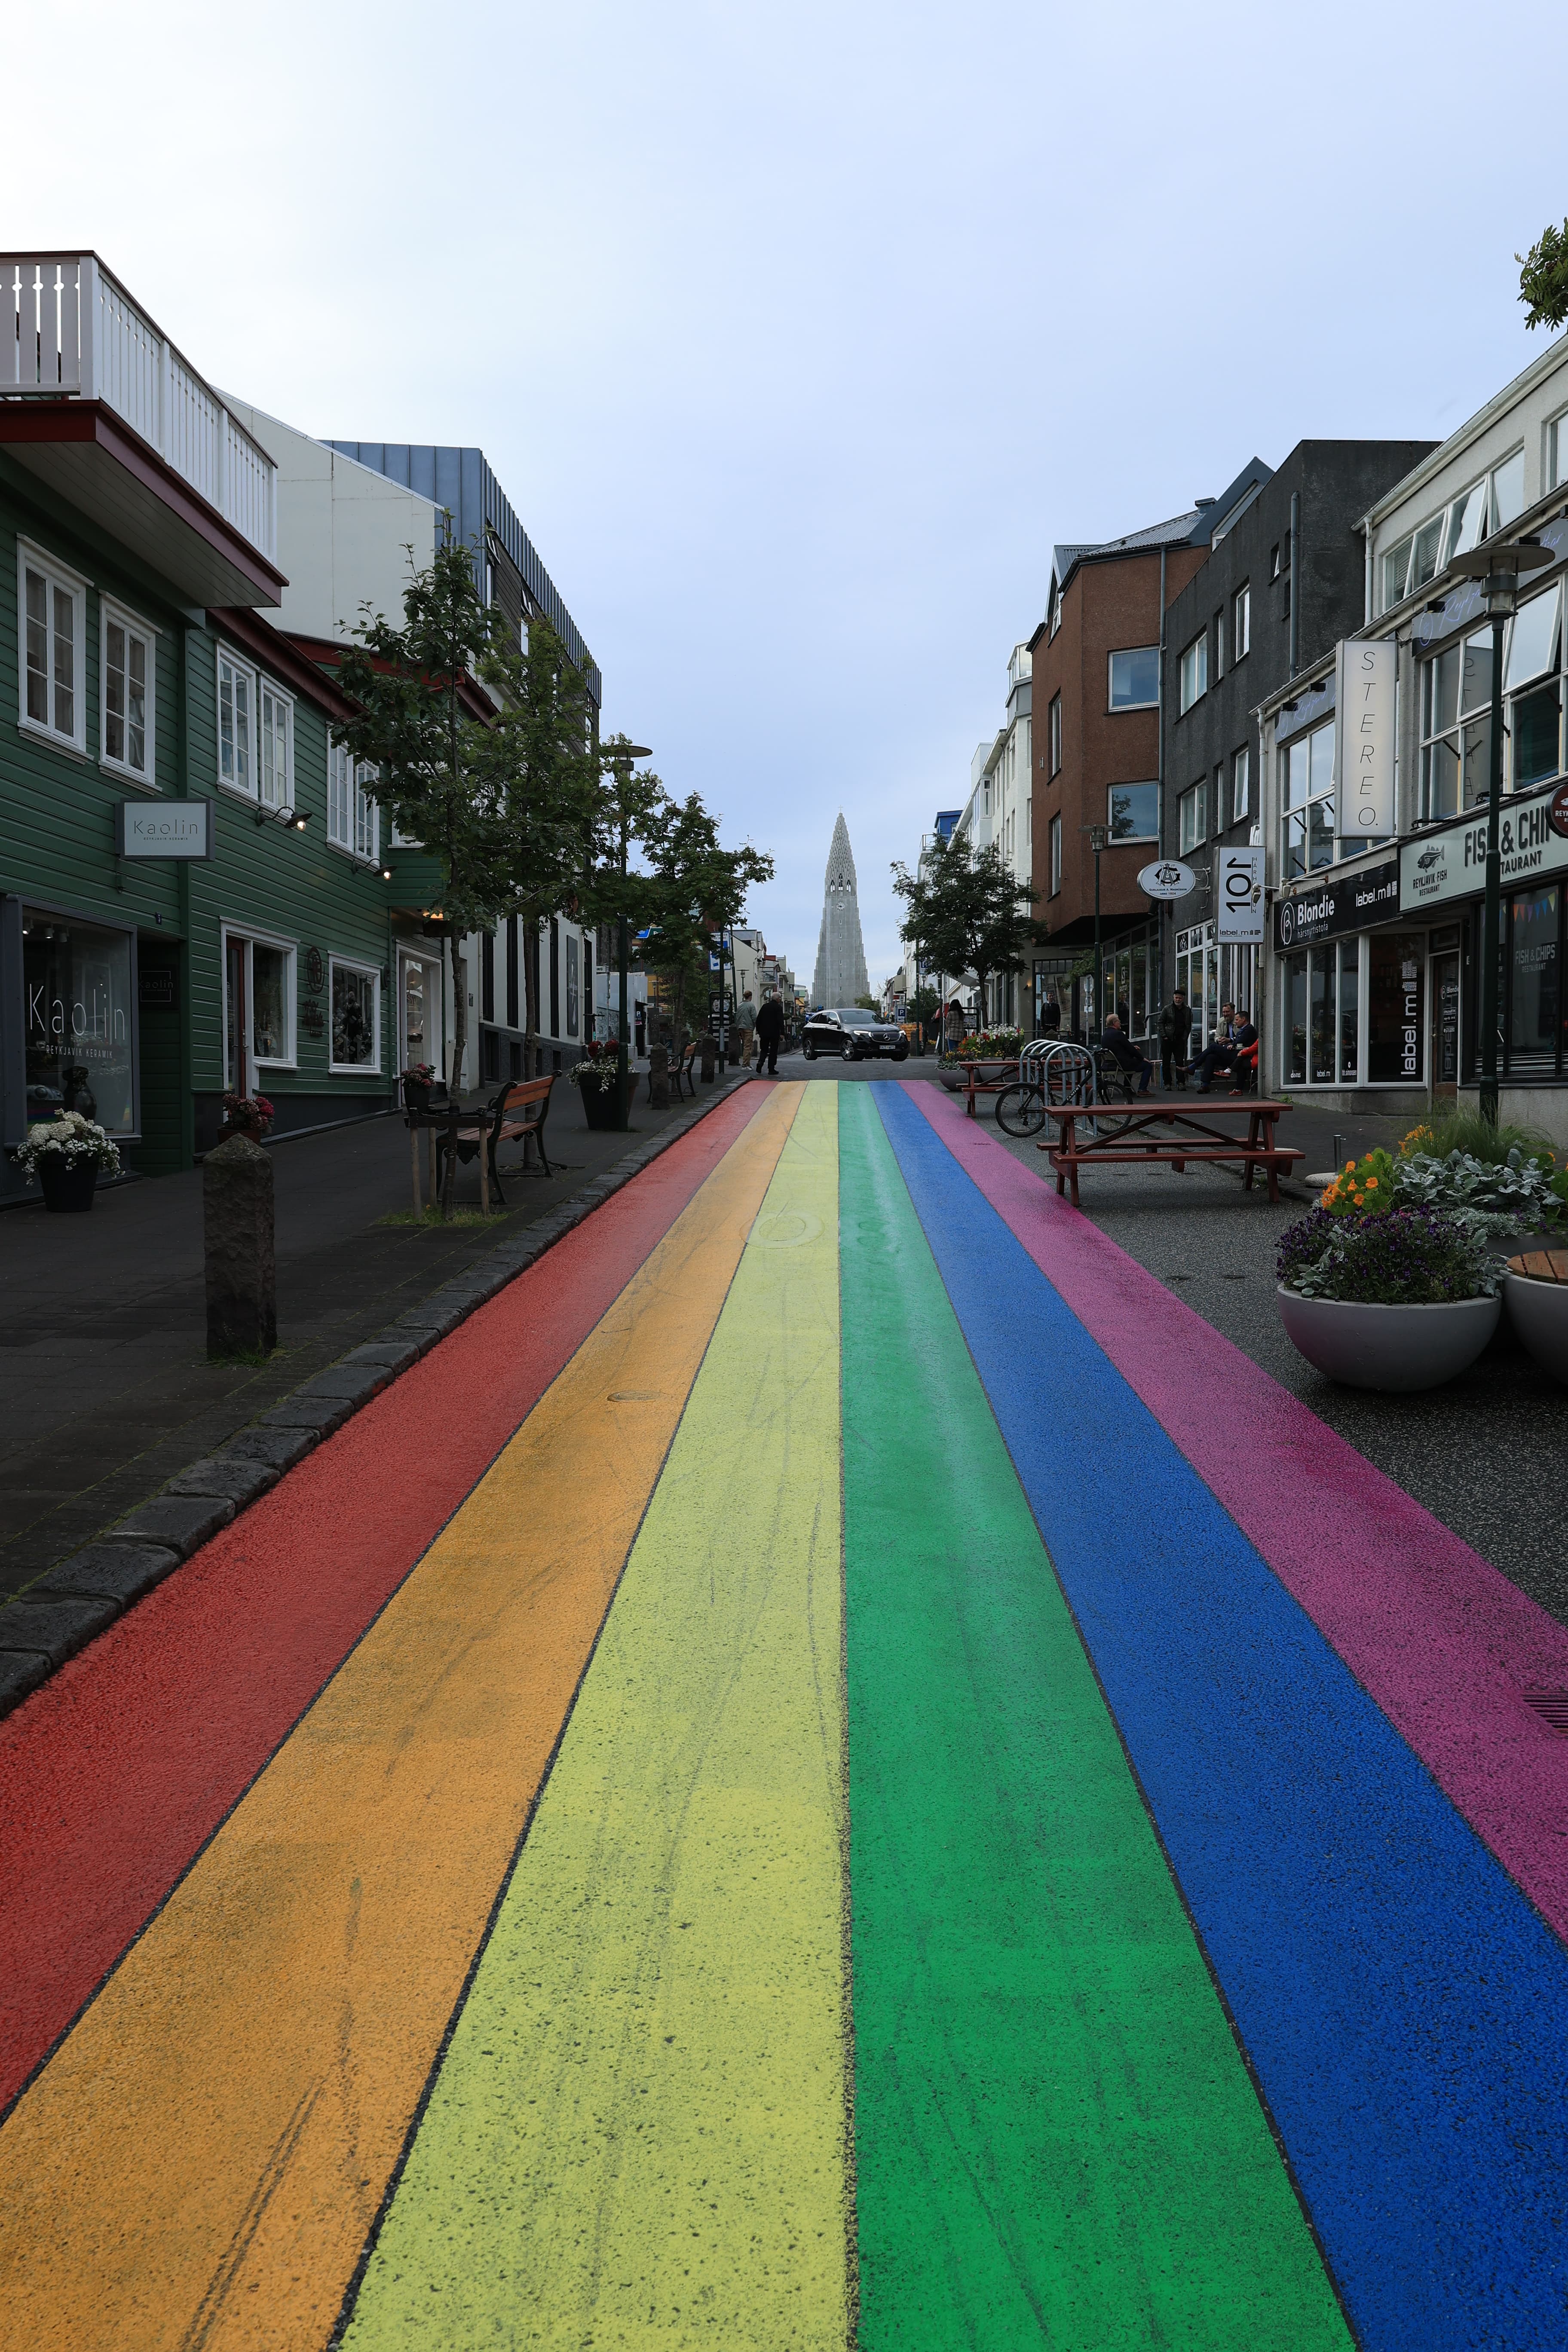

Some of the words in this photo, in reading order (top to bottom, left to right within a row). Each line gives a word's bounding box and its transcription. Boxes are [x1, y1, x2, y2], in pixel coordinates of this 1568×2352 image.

[1358, 652, 1378, 826] STEREO.
[135, 819, 198, 834] Kaolin
[1501, 820, 1514, 855] &
[1500, 850, 1542, 875] TAURANT
[1226, 858, 1251, 913] 101
[1413, 873, 1435, 889] REYKJAVIK
[1437, 869, 1447, 882] FISH
[1356, 888, 1386, 907] label.m
[1419, 884, 1440, 896] RESTAURANT
[1298, 894, 1335, 925] Blondie
[1297, 920, 1329, 939] hársnyrtistofa
[1515, 949, 1529, 965] FISH
[1530, 949, 1535, 961] &
[1536, 944, 1556, 961] CHIPS
[1522, 963, 1546, 973] RESTAURANT
[138, 980, 173, 988] Kaolin
[29, 983, 126, 1040] Kaolin
[1401, 995, 1417, 1075] label.m
[46, 1044, 82, 1056] REYKJAVIK
[86, 1049, 113, 1059] KERAMIK
